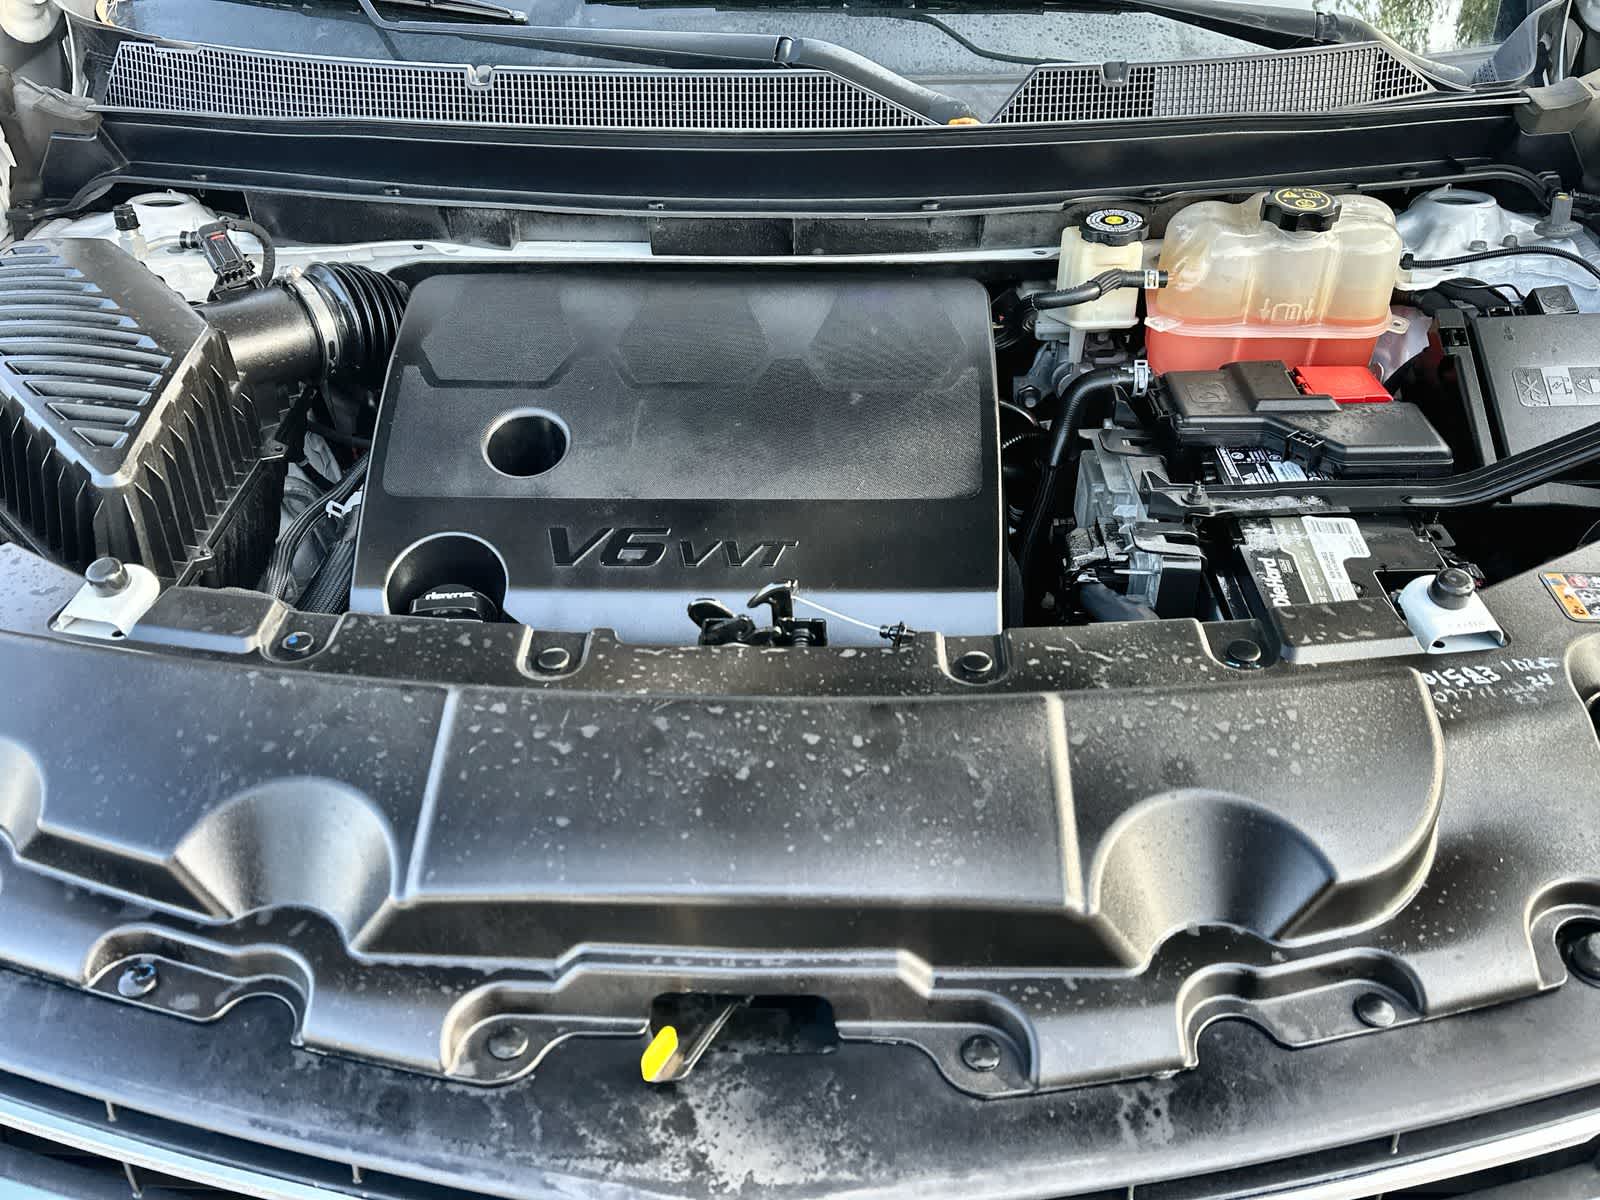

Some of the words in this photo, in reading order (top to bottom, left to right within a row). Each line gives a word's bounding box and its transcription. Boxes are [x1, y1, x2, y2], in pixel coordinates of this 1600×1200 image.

[548, 527, 671, 567] V6
[680, 540, 799, 568] VVT
[1258, 557, 1291, 606] DieHard
